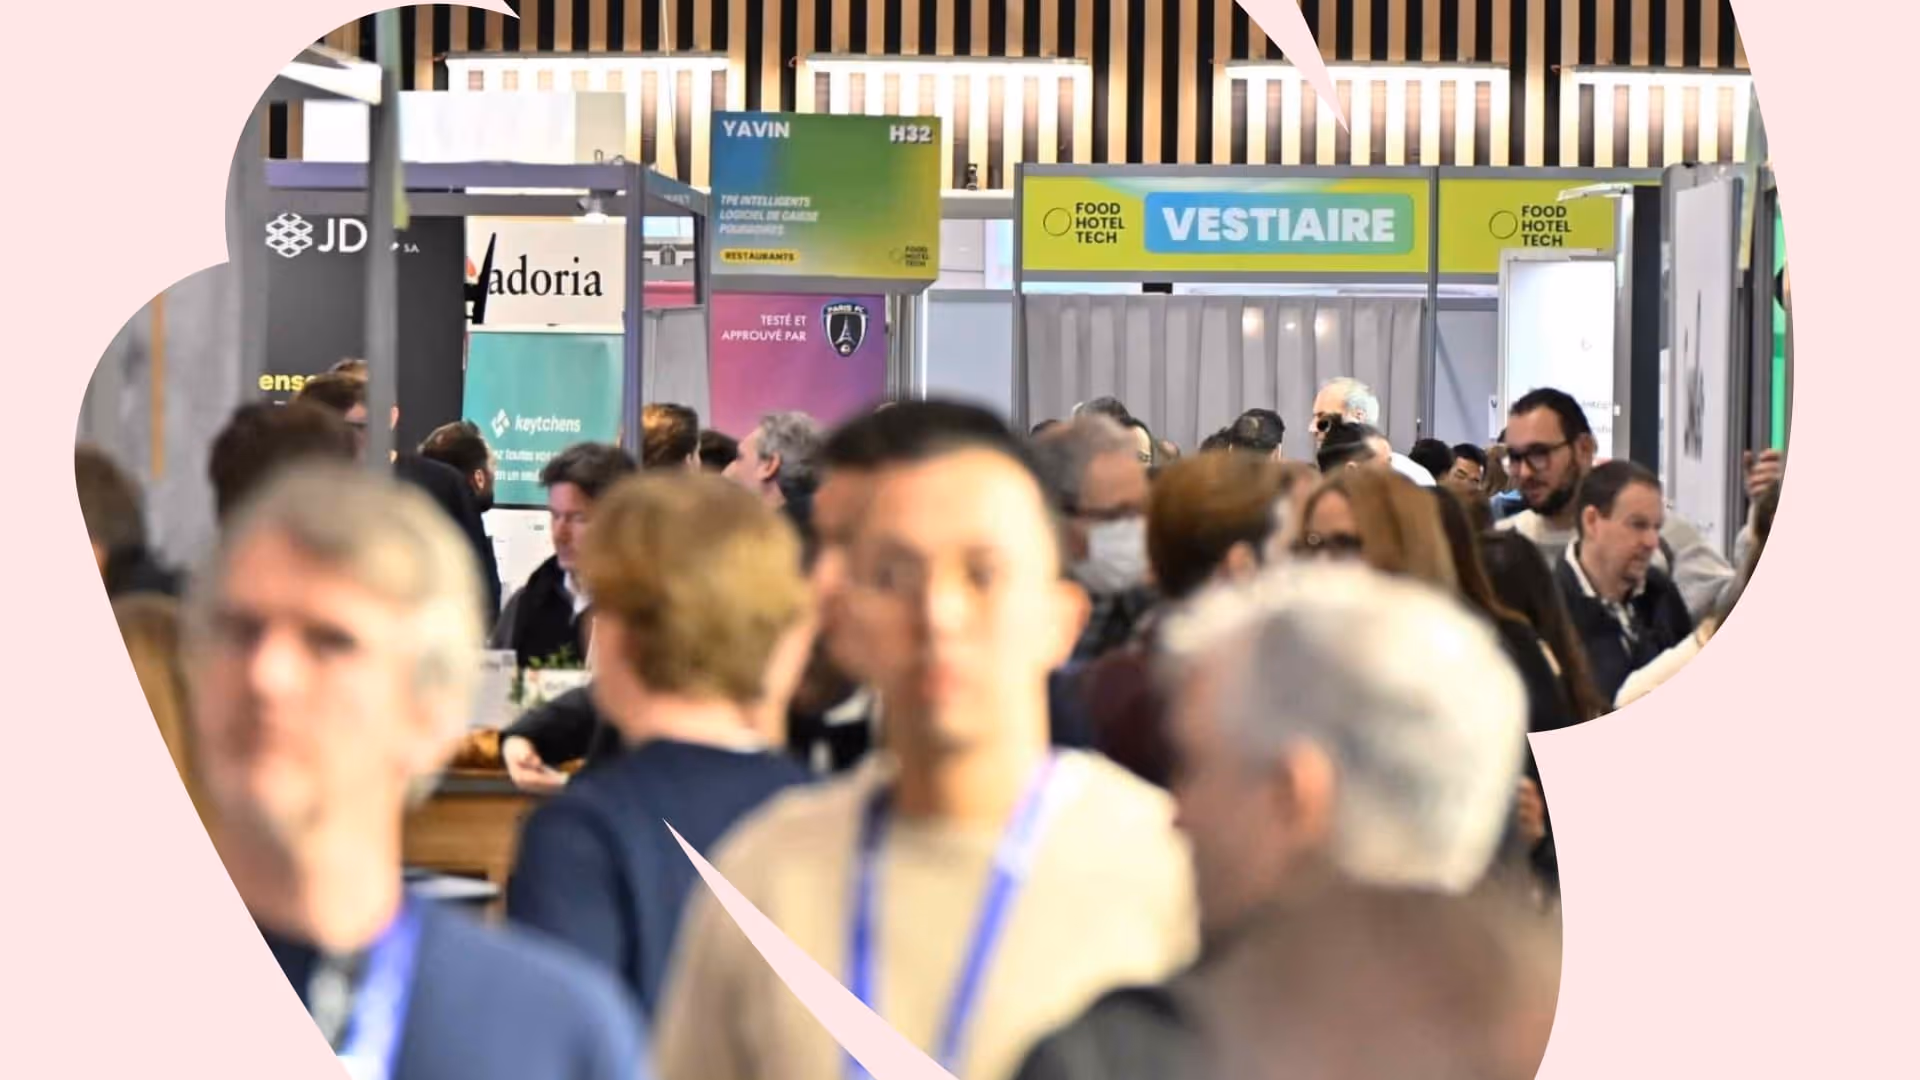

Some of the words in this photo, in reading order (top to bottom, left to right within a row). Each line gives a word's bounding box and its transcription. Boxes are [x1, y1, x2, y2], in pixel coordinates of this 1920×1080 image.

[722, 120, 790, 139] YAVIN
[889, 124, 933, 144] H32
[740, 195, 811, 208] INTELLIGENTS
[1076, 202, 1121, 215] FOOD
[1521, 205, 1567, 217] FOOD
[1076, 217, 1126, 229] HOTEL
[1161, 206, 1396, 243] VESTIAIRE
[1521, 220, 1572, 232] HOTEL
[317, 218, 397, 253] JD
[1076, 231, 1118, 244] TECH
[1521, 234, 1564, 247] TECH
[725, 251, 795, 261] RESTAURANTS
[488, 254, 603, 297] adoria
[828, 304, 852, 313] PARIS
[854, 305, 865, 313] FC
[761, 313, 792, 326] TESTÉ
[795, 315, 807, 326] ET
[721, 329, 782, 342] APPROUVÉ
[785, 330, 807, 342] PAR
[515, 414, 582, 436] keytchens
